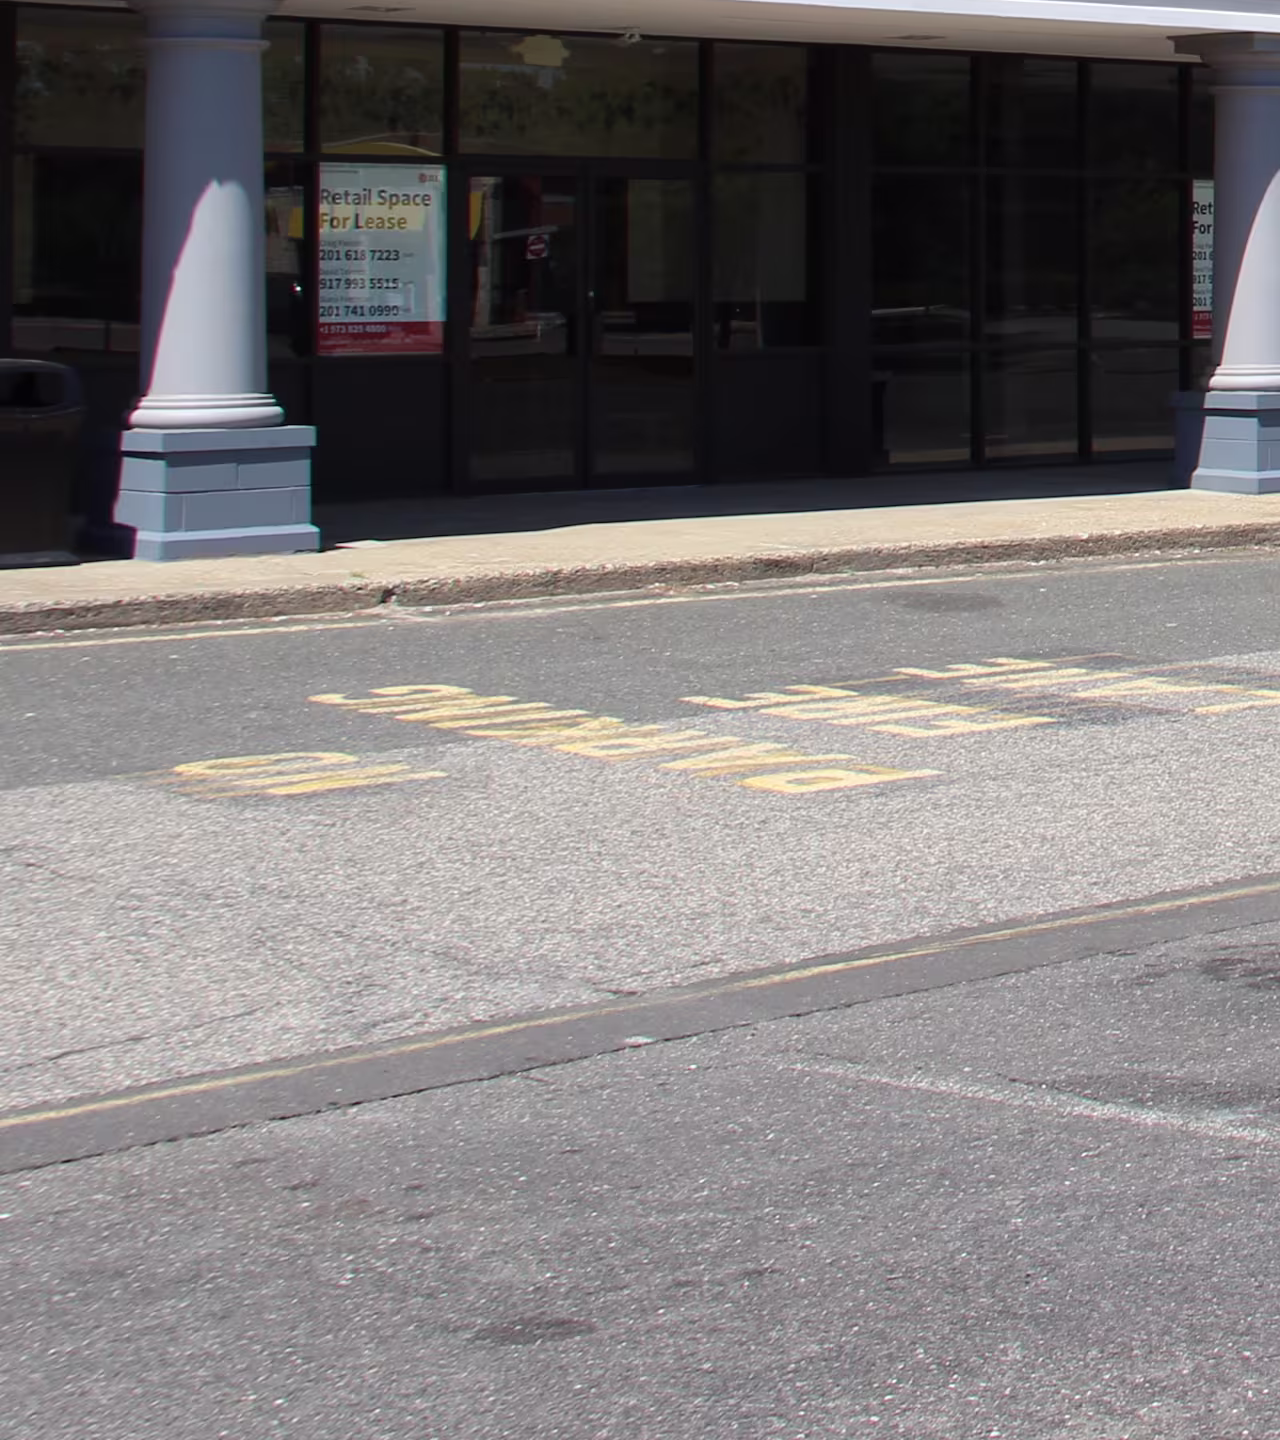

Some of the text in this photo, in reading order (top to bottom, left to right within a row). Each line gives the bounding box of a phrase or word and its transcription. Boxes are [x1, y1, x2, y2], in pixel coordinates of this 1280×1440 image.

[320, 188, 432, 210] Retail Space
[320, 213, 407, 230] For Lease
[320, 250, 400, 261] 201 618 7223
[320, 278, 400, 290] 917 993 5515
[344, 305, 365, 317] 741
[679, 684, 1057, 738] FIRE
[307, 684, 950, 795] PARKING
